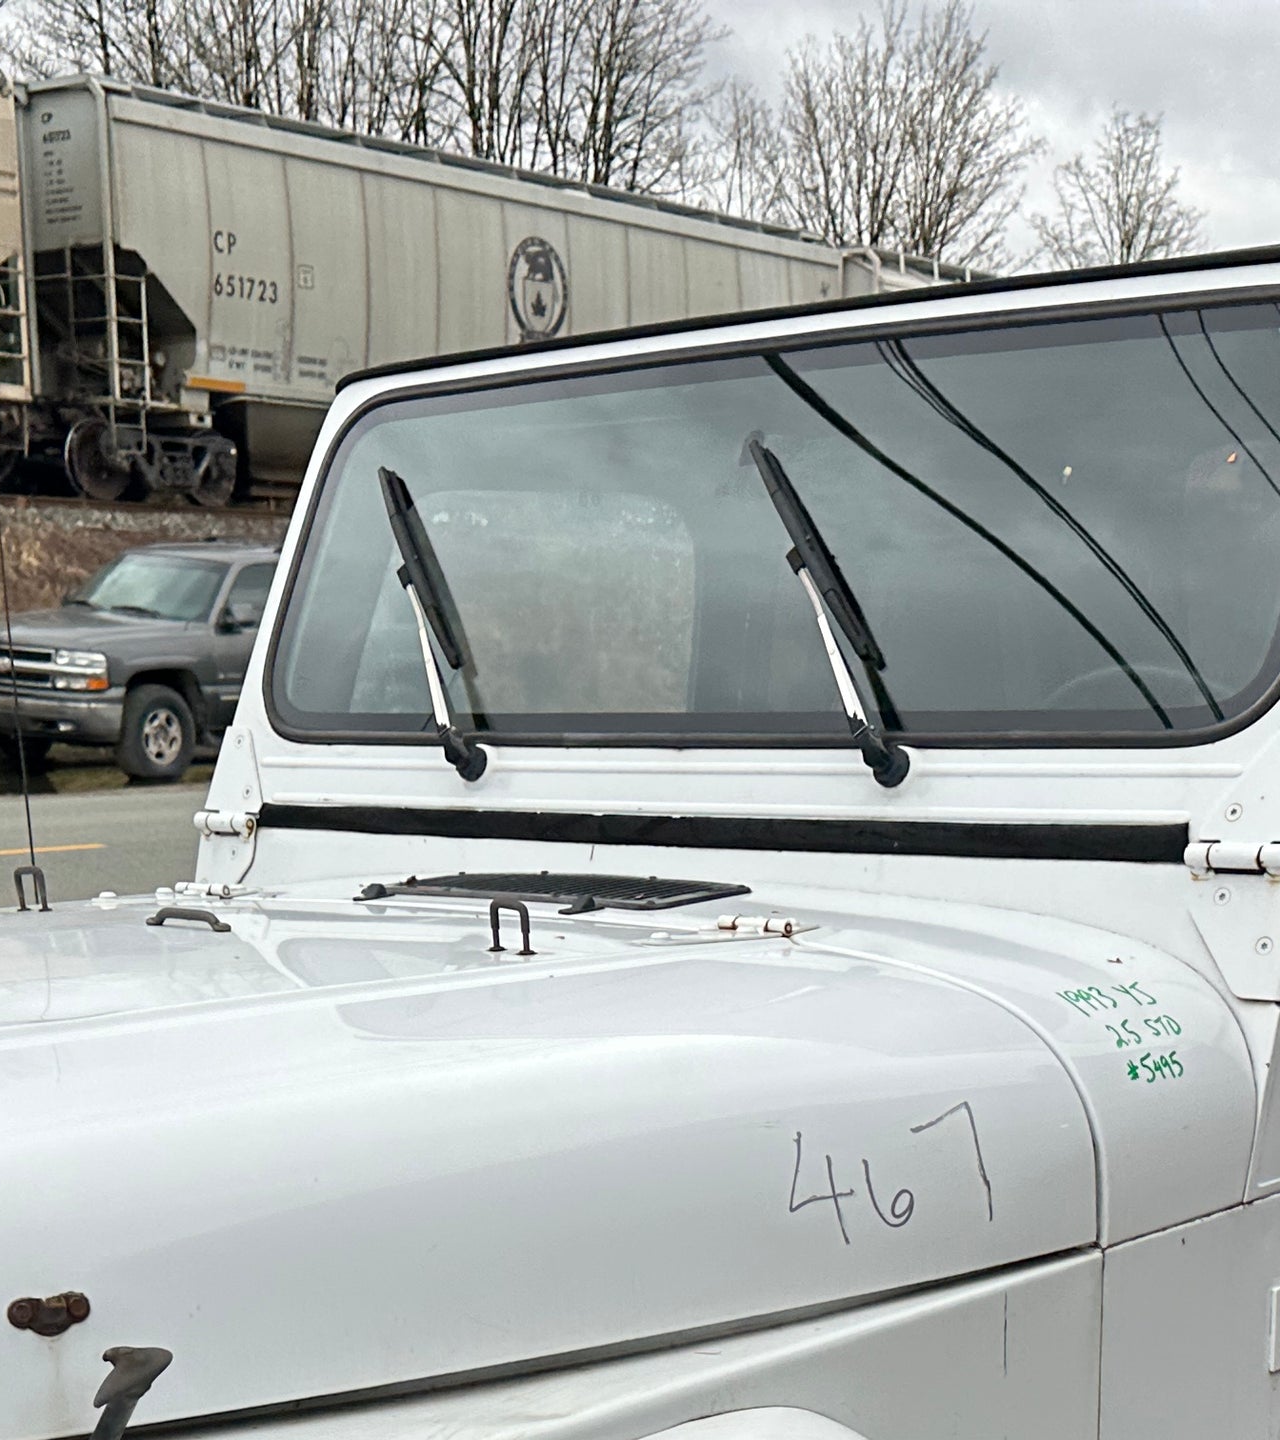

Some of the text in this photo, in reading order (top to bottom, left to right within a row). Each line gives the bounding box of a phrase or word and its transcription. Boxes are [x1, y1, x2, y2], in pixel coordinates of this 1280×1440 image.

[213, 231, 236, 254] CP
[213, 273, 278, 304] 651723
[1055, 981, 1157, 1018] 1993 YJ
[1126, 1050, 1184, 1083] #5495
[789, 1101, 993, 1244] 467
